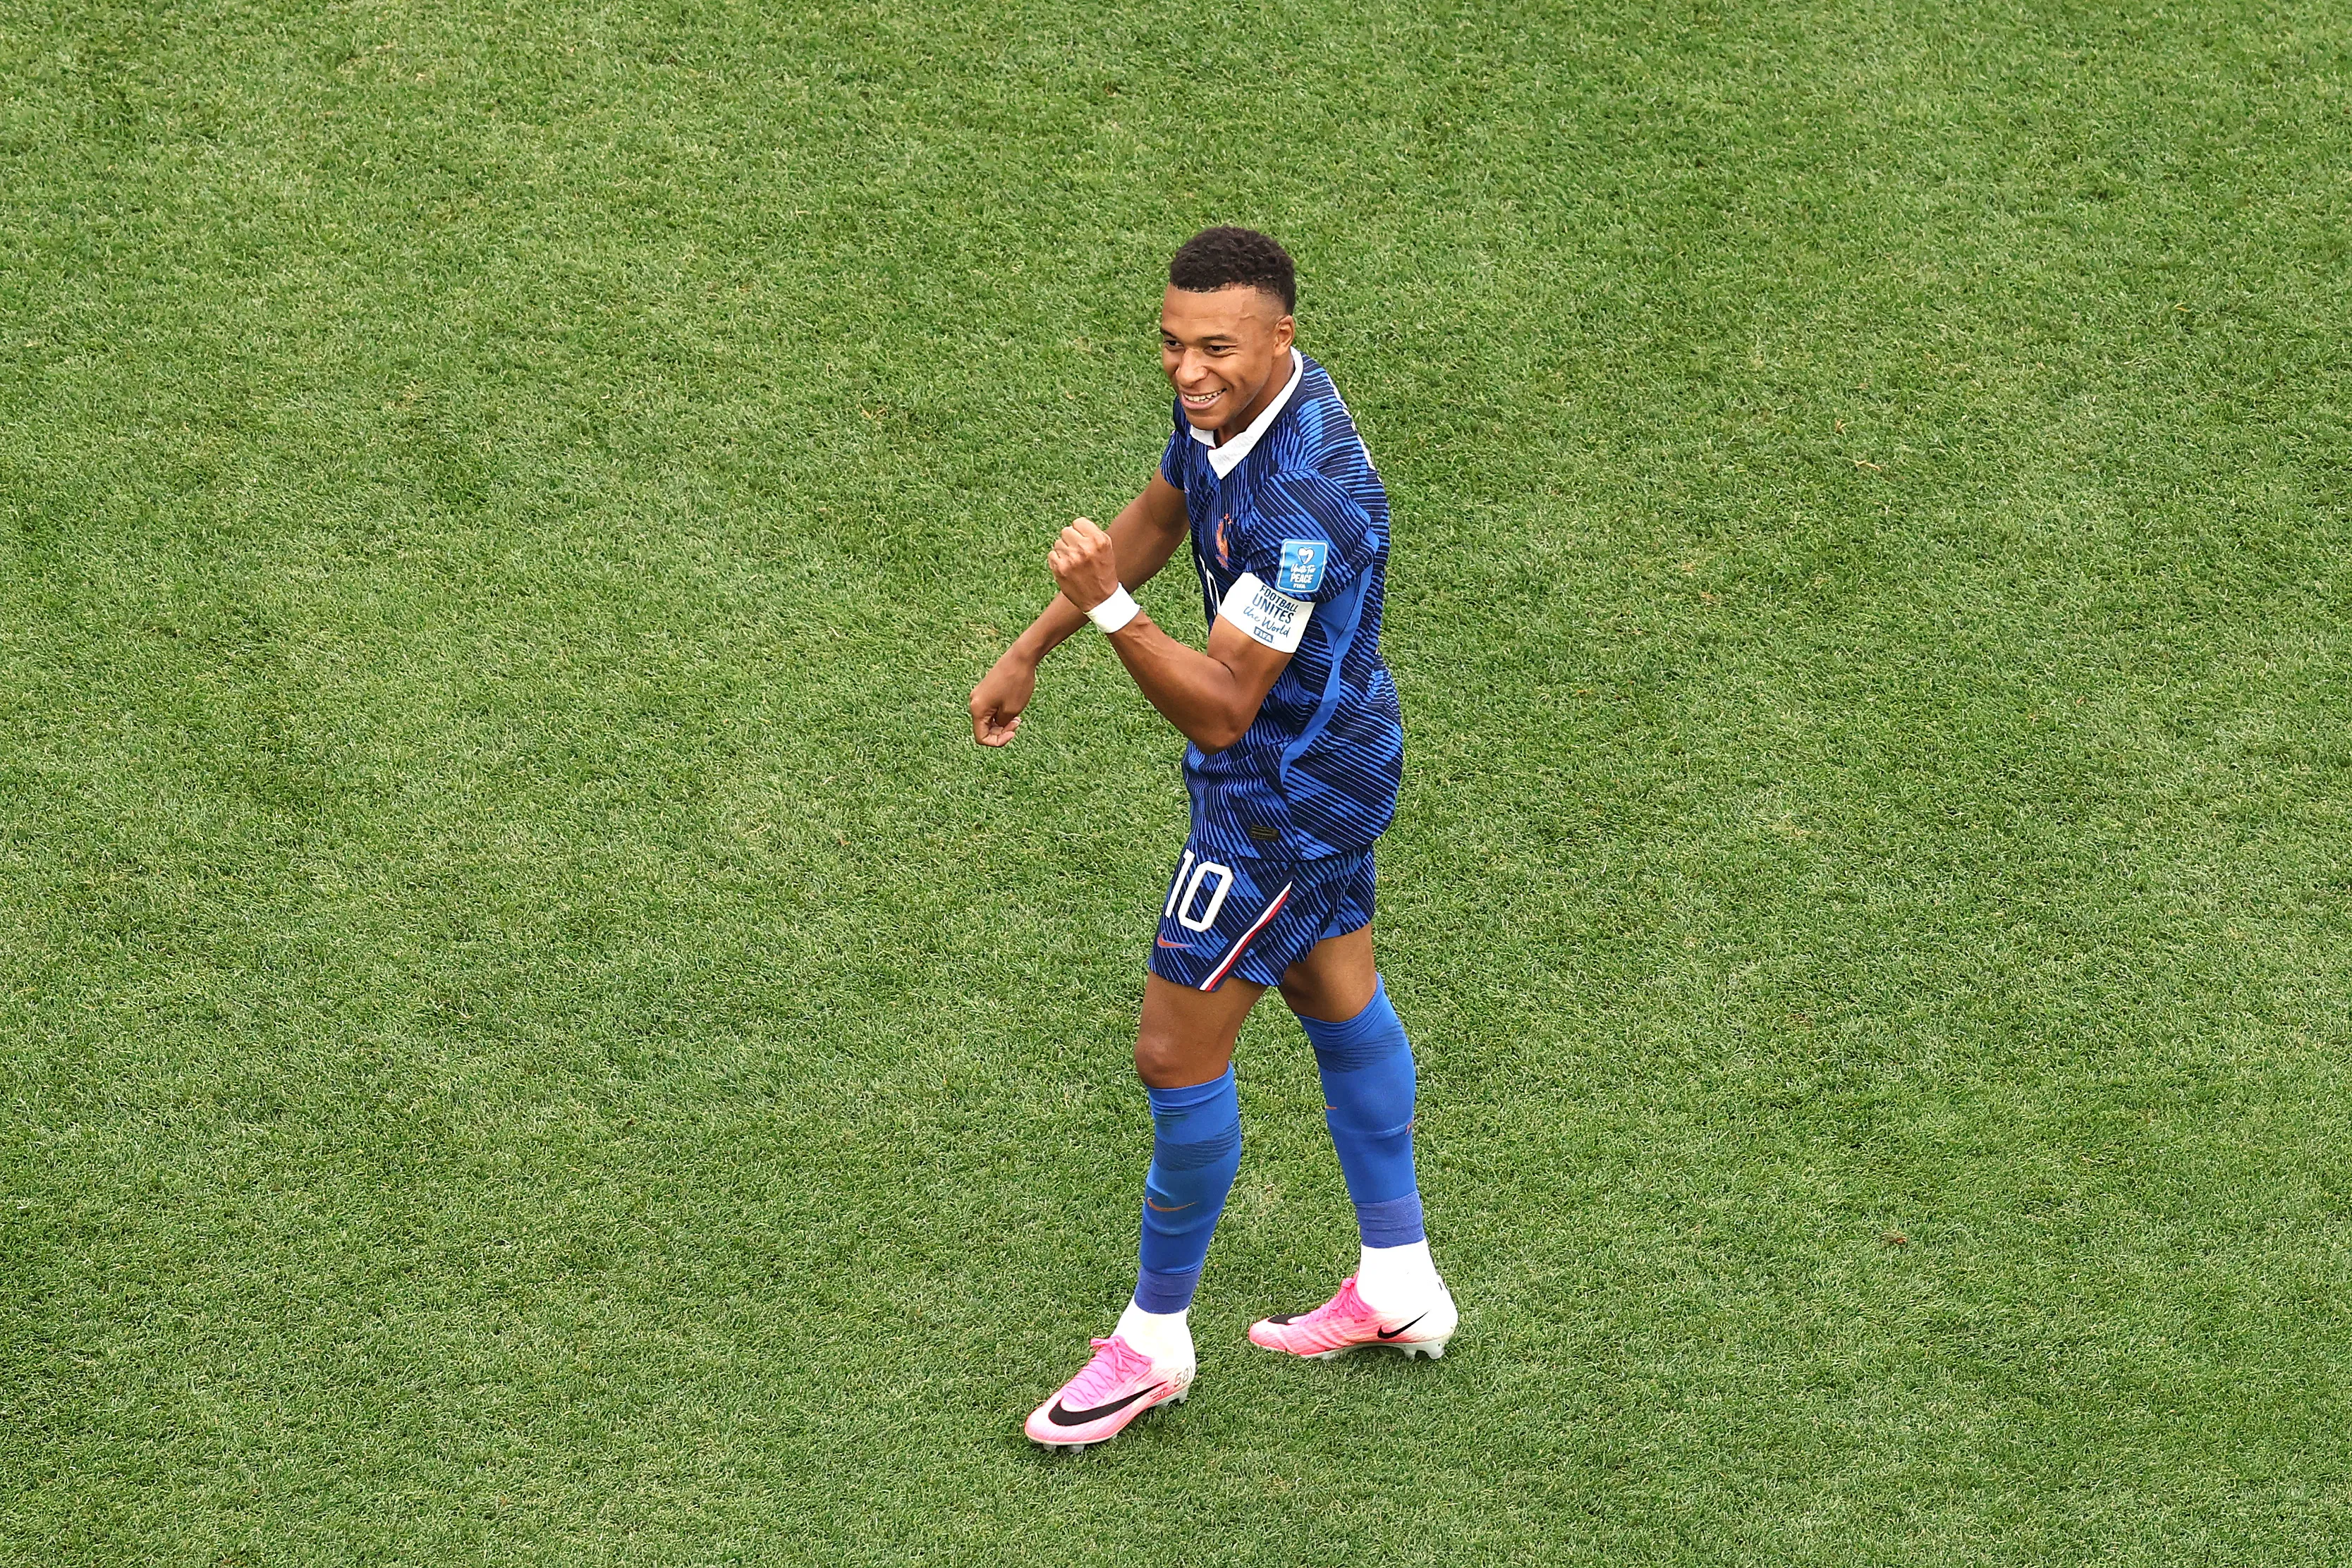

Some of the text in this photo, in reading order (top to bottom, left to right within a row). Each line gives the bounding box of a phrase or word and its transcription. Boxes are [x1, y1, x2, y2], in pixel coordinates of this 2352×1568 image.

[1290, 573, 1313, 584] PEACE
[1252, 593, 1294, 624] UNITES
[1259, 584, 1298, 612] FOOTBALL
[1243, 605, 1291, 638] the World
[1253, 626, 1274, 644] FIFA
[1165, 848, 1235, 933] 10
